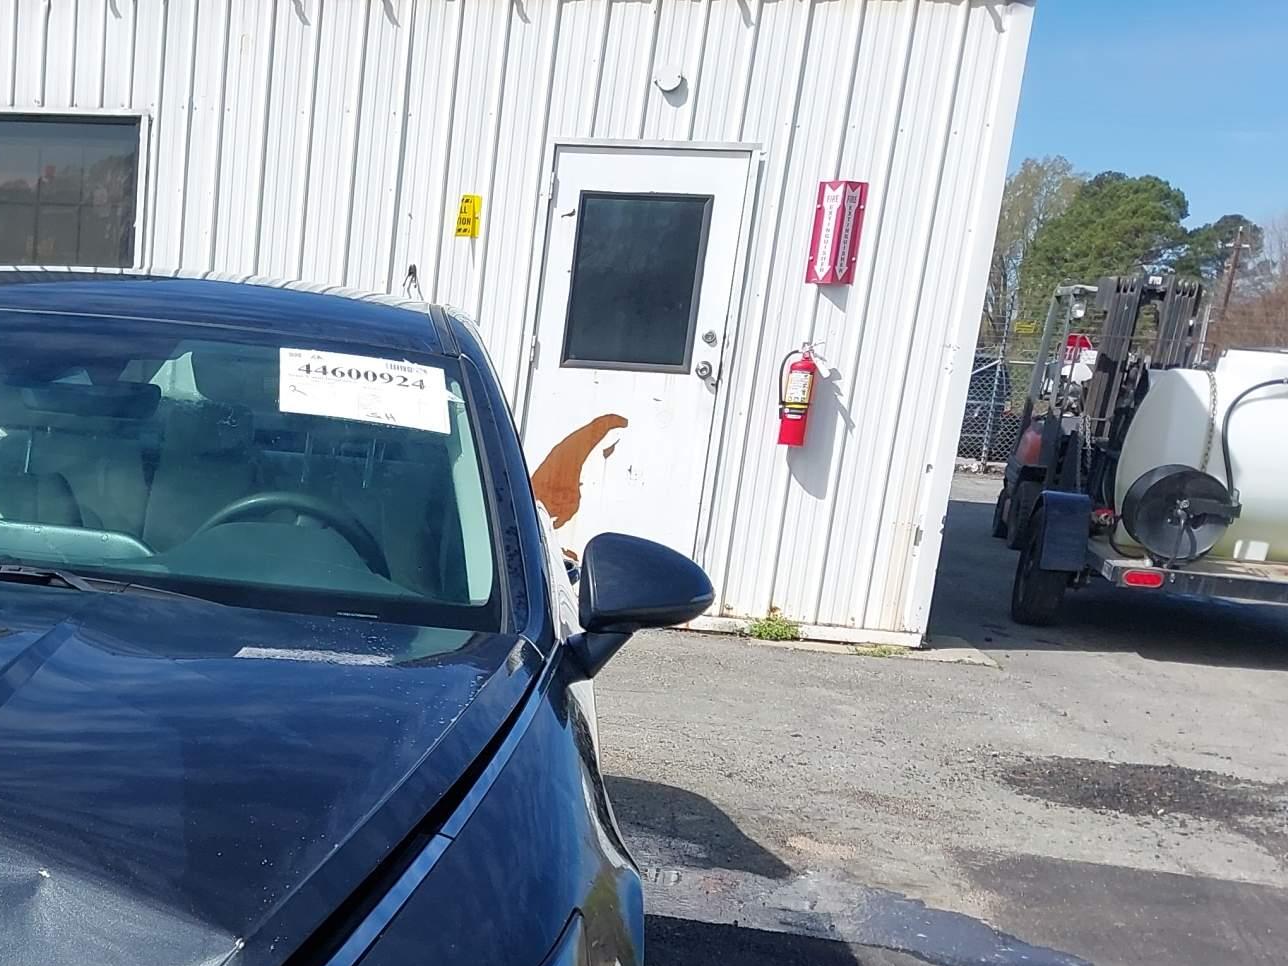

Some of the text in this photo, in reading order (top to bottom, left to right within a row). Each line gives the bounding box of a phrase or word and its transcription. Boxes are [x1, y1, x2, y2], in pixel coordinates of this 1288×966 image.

[827, 195, 839, 203] FIRE
[847, 195, 857, 203] FIRE
[838, 205, 852, 274] EXTINGUISHER
[298, 363, 425, 390] 44600924
